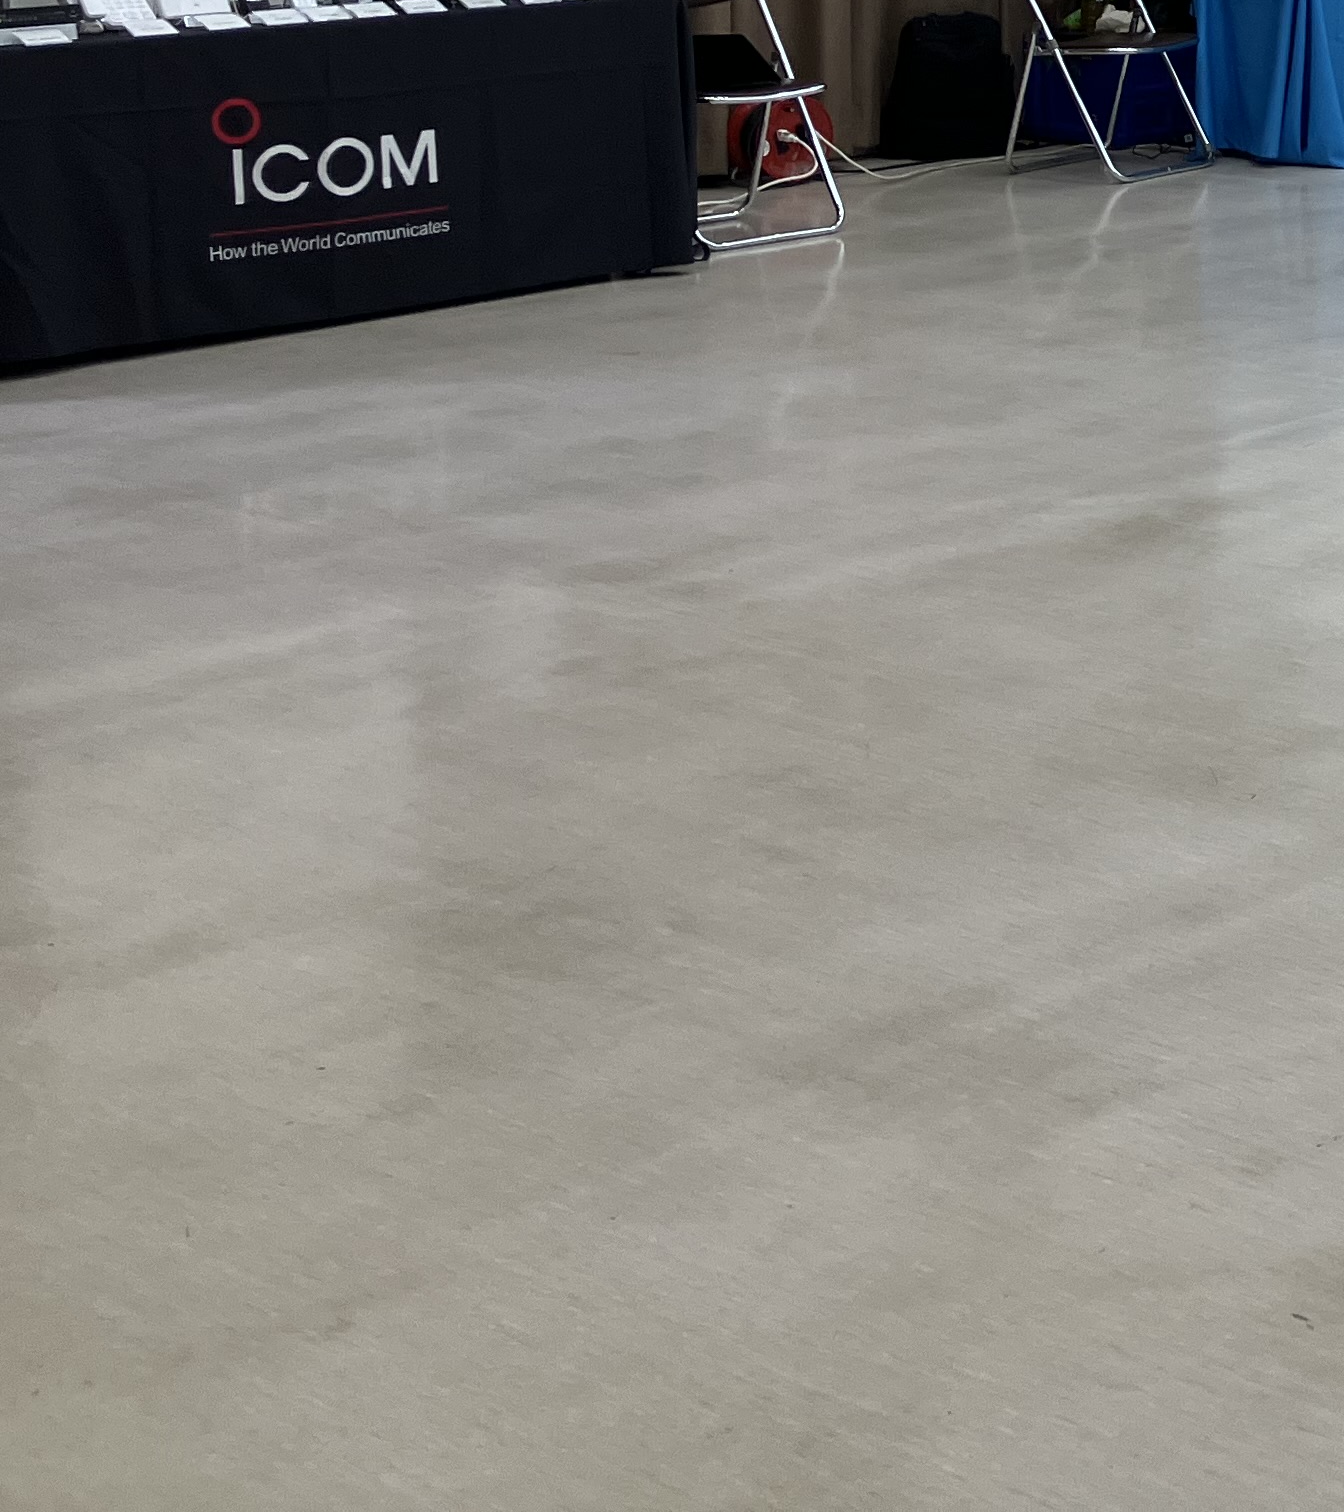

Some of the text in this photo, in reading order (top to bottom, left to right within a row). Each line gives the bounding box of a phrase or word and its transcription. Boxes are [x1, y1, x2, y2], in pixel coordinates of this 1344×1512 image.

[209, 220, 450, 262] How the World Communicates
